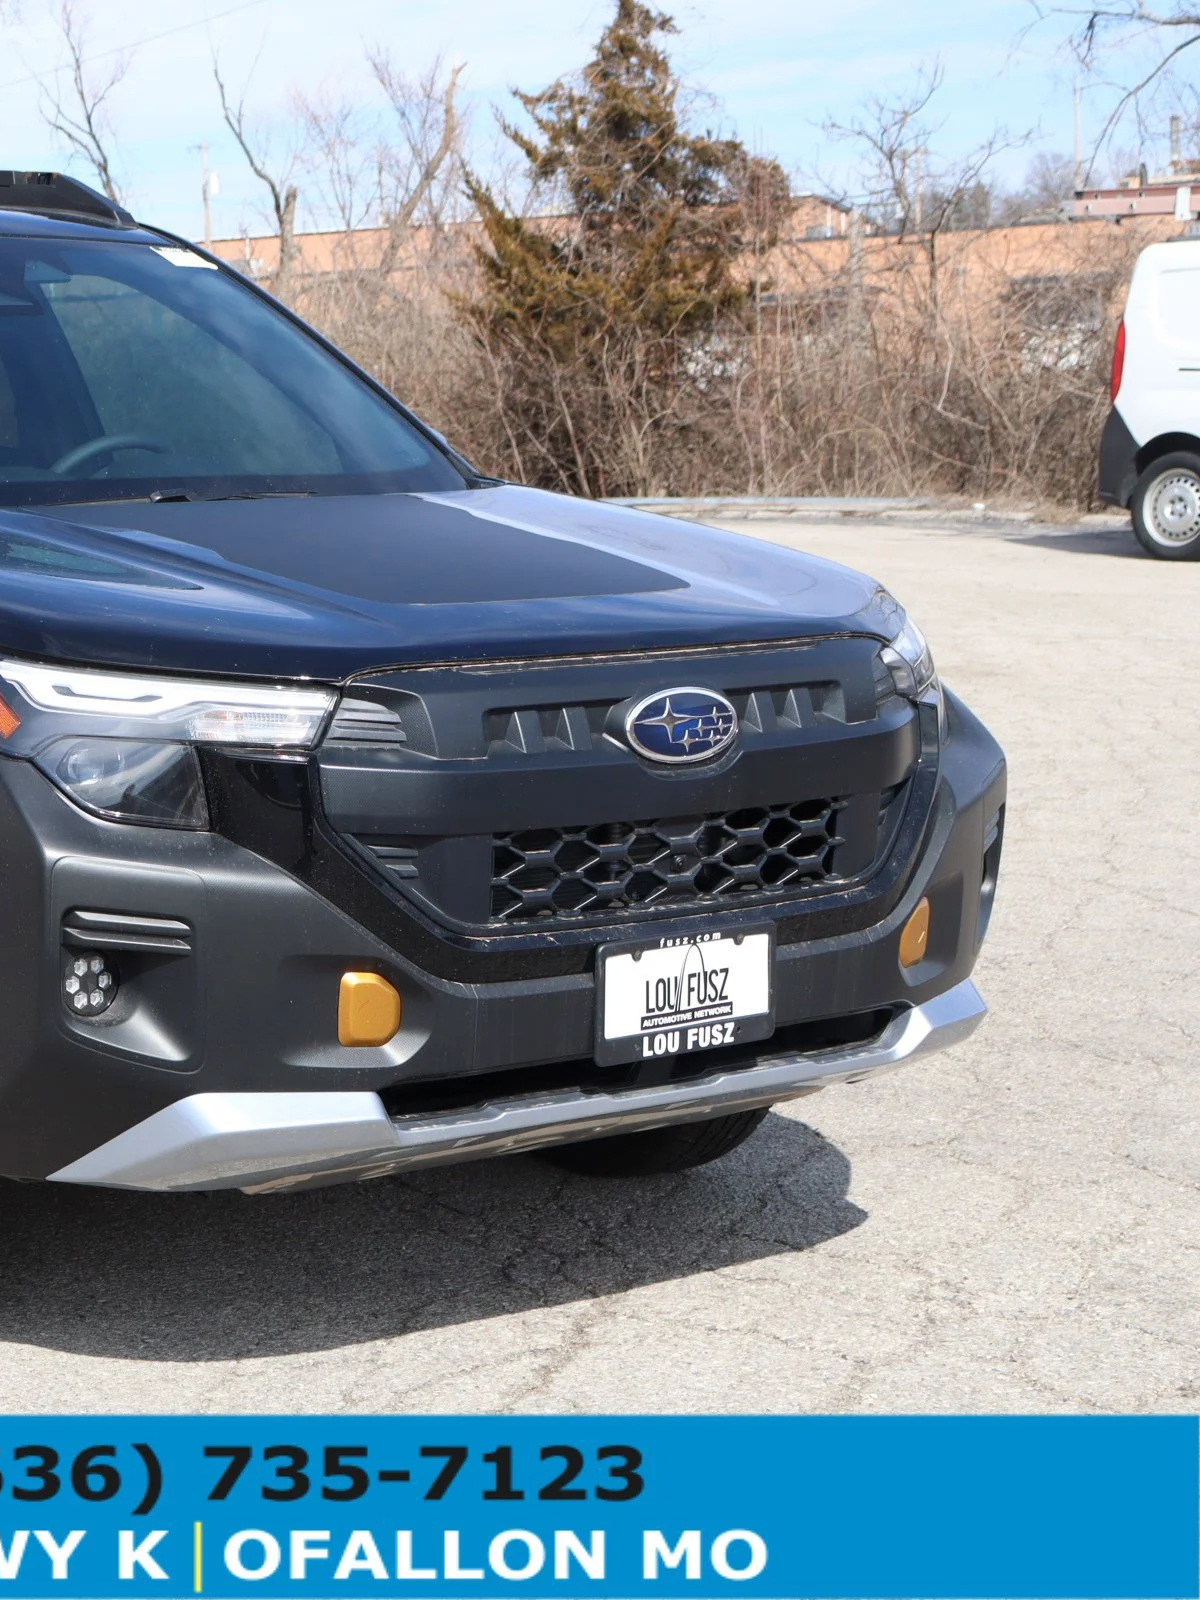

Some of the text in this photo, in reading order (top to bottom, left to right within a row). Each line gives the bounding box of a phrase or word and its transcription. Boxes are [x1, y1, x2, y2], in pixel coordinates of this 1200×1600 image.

[660, 932, 721, 948] fusz.com
[646, 967, 729, 1013] LOU FUSZ
[643, 1005, 732, 1028] AUTOMOTIVE NETWORK
[643, 1022, 735, 1057] LOU FUSZ
